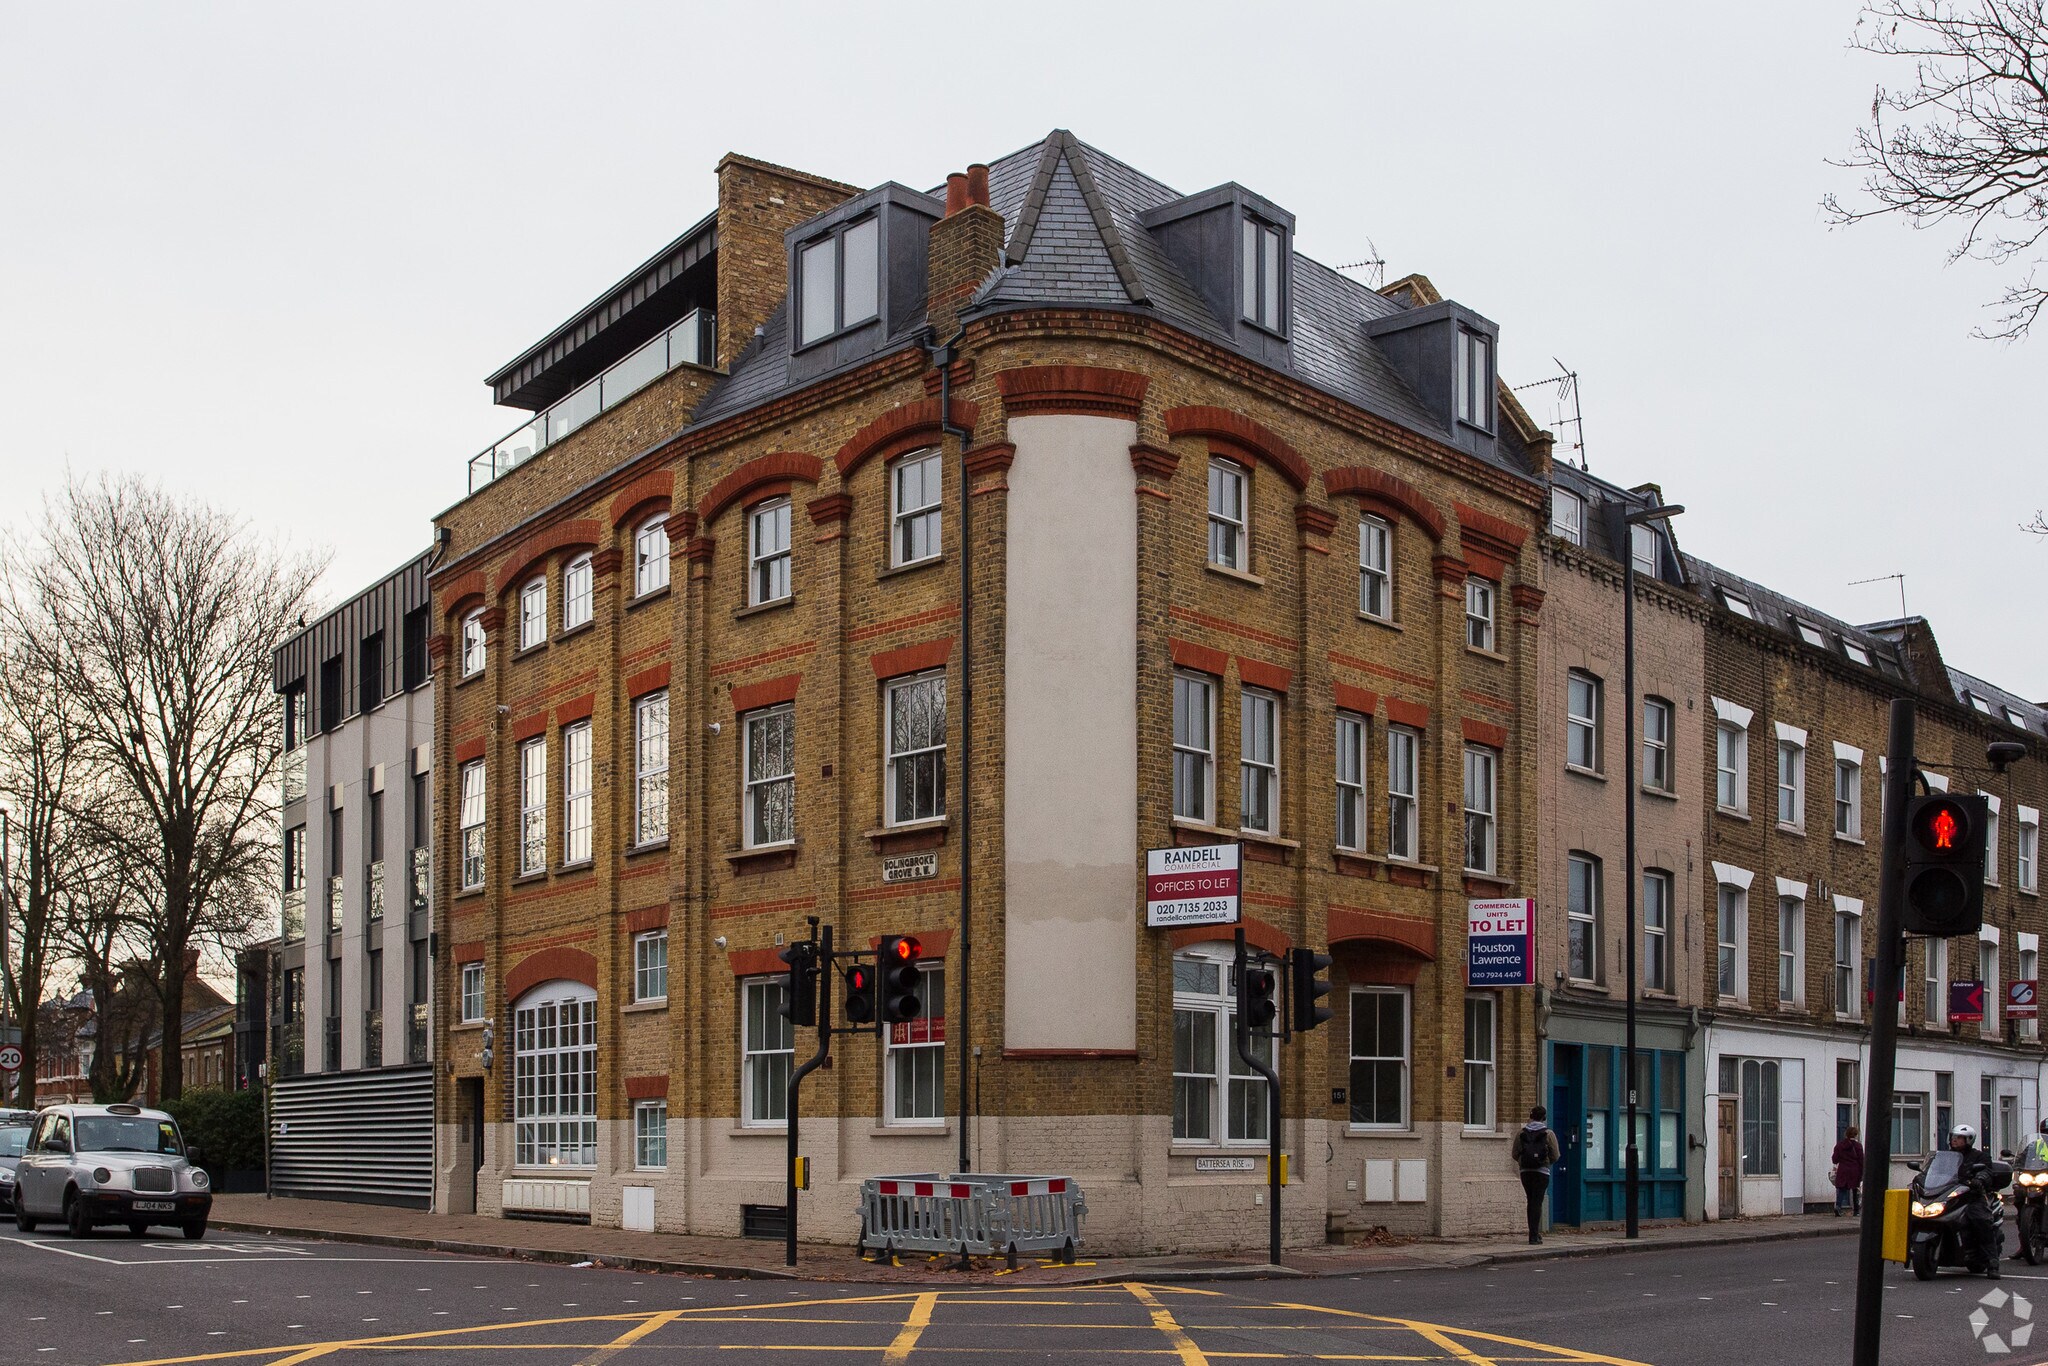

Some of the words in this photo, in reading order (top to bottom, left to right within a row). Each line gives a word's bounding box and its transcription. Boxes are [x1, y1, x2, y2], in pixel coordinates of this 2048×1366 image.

[1164, 848, 1221, 864] RANDELL
[884, 855, 934, 870] BOLINGBROKE
[1164, 862, 1221, 872] COMMERCIAL
[888, 868, 912, 879] GROVE
[1155, 880, 1195, 892] OFFICES
[1198, 879, 1212, 890] TO
[1214, 878, 1230, 888] LET
[1156, 904, 1174, 914] 020
[1178, 902, 1200, 913] 7135
[1203, 901, 1228, 912] 2033
[1156, 912, 1228, 922] randellcommercial.uk
[1470, 920, 1492, 932] TO
[1496, 920, 1524, 932] LET
[1472, 943, 1514, 953] Houston
[1472, 955, 1521, 964] Lawrence
[1, 1053, 20, 1063] 20
